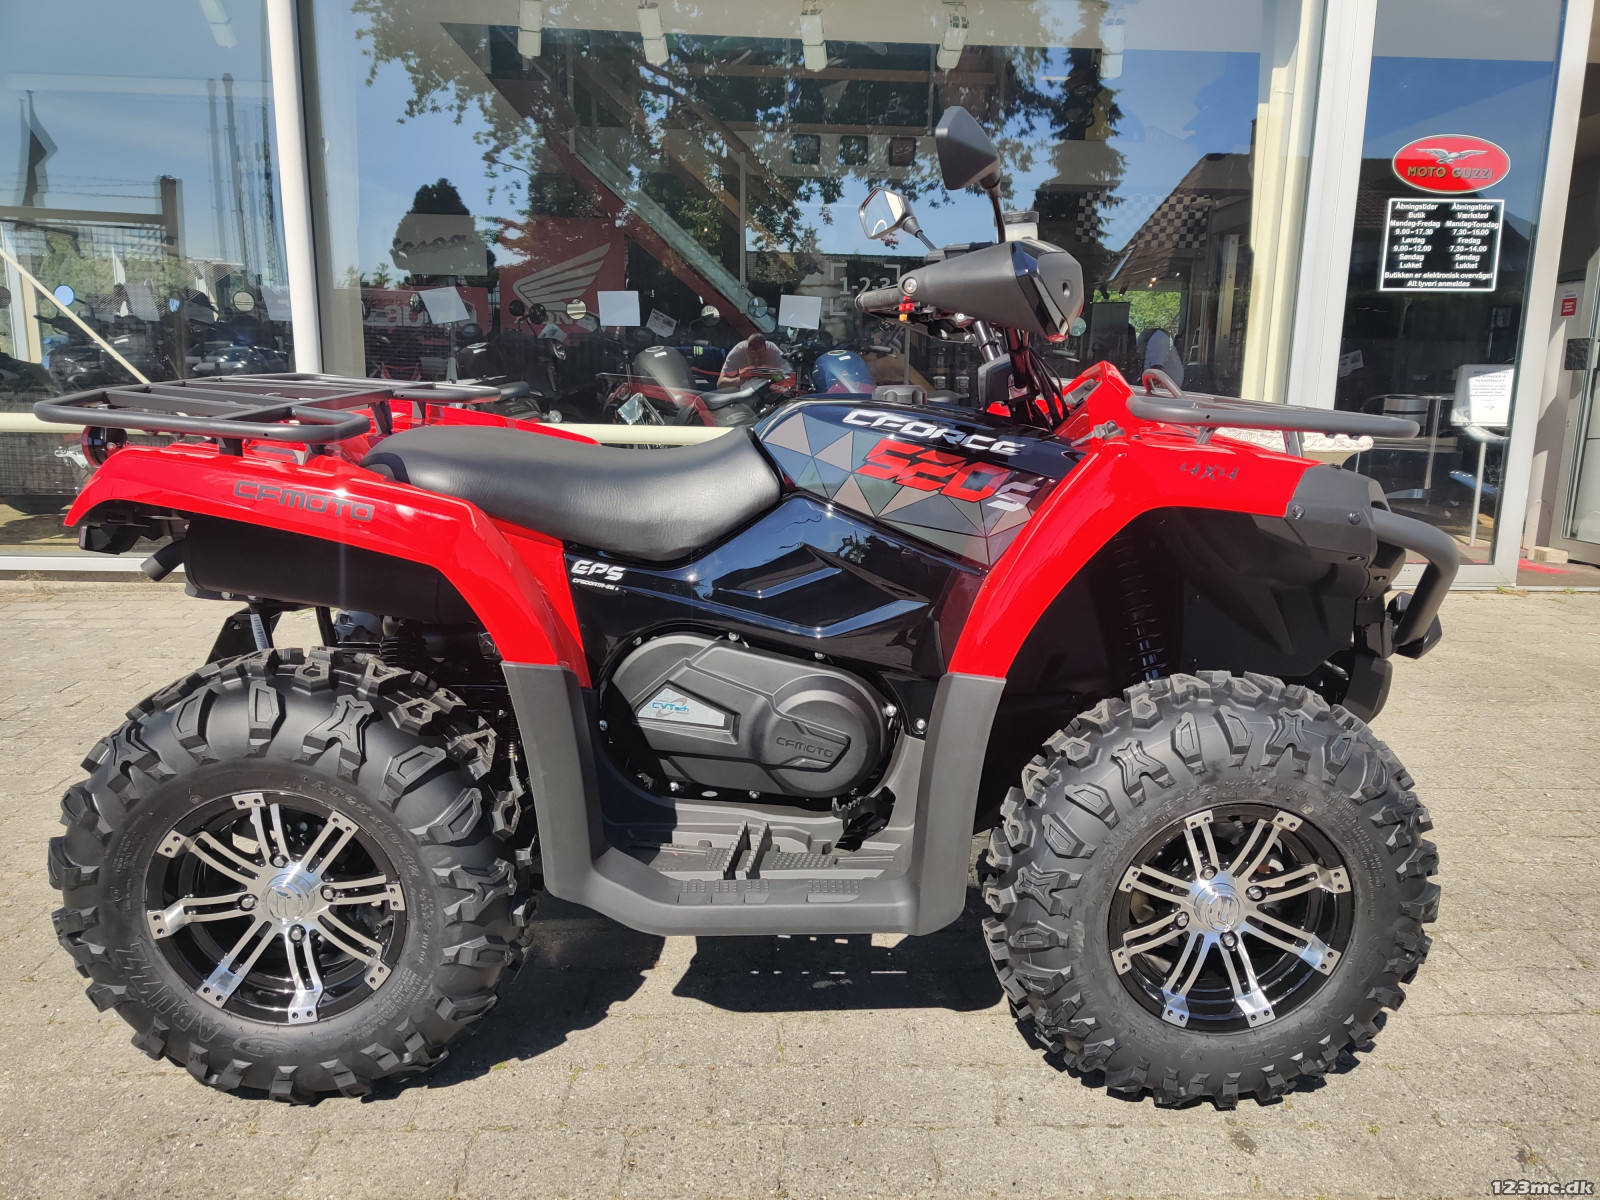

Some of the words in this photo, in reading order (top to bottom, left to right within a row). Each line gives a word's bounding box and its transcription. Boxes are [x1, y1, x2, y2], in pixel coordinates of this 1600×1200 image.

[1407, 166, 1446, 178] MOTO
[1452, 168, 1493, 180] GUZZI
[1390, 220, 1441, 228] Mandag-Fredag
[1445, 221, 1499, 229] Mandag-Torsdag
[1457, 237, 1481, 245] Fredag
[1418, 280, 1438, 288] tyveri
[842, 408, 1026, 456] CFORCE
[854, 438, 1012, 503] 520
[234, 480, 376, 522] CFMOTO
[571, 559, 627, 581] EPS
[776, 736, 834, 758] CFMOTO
